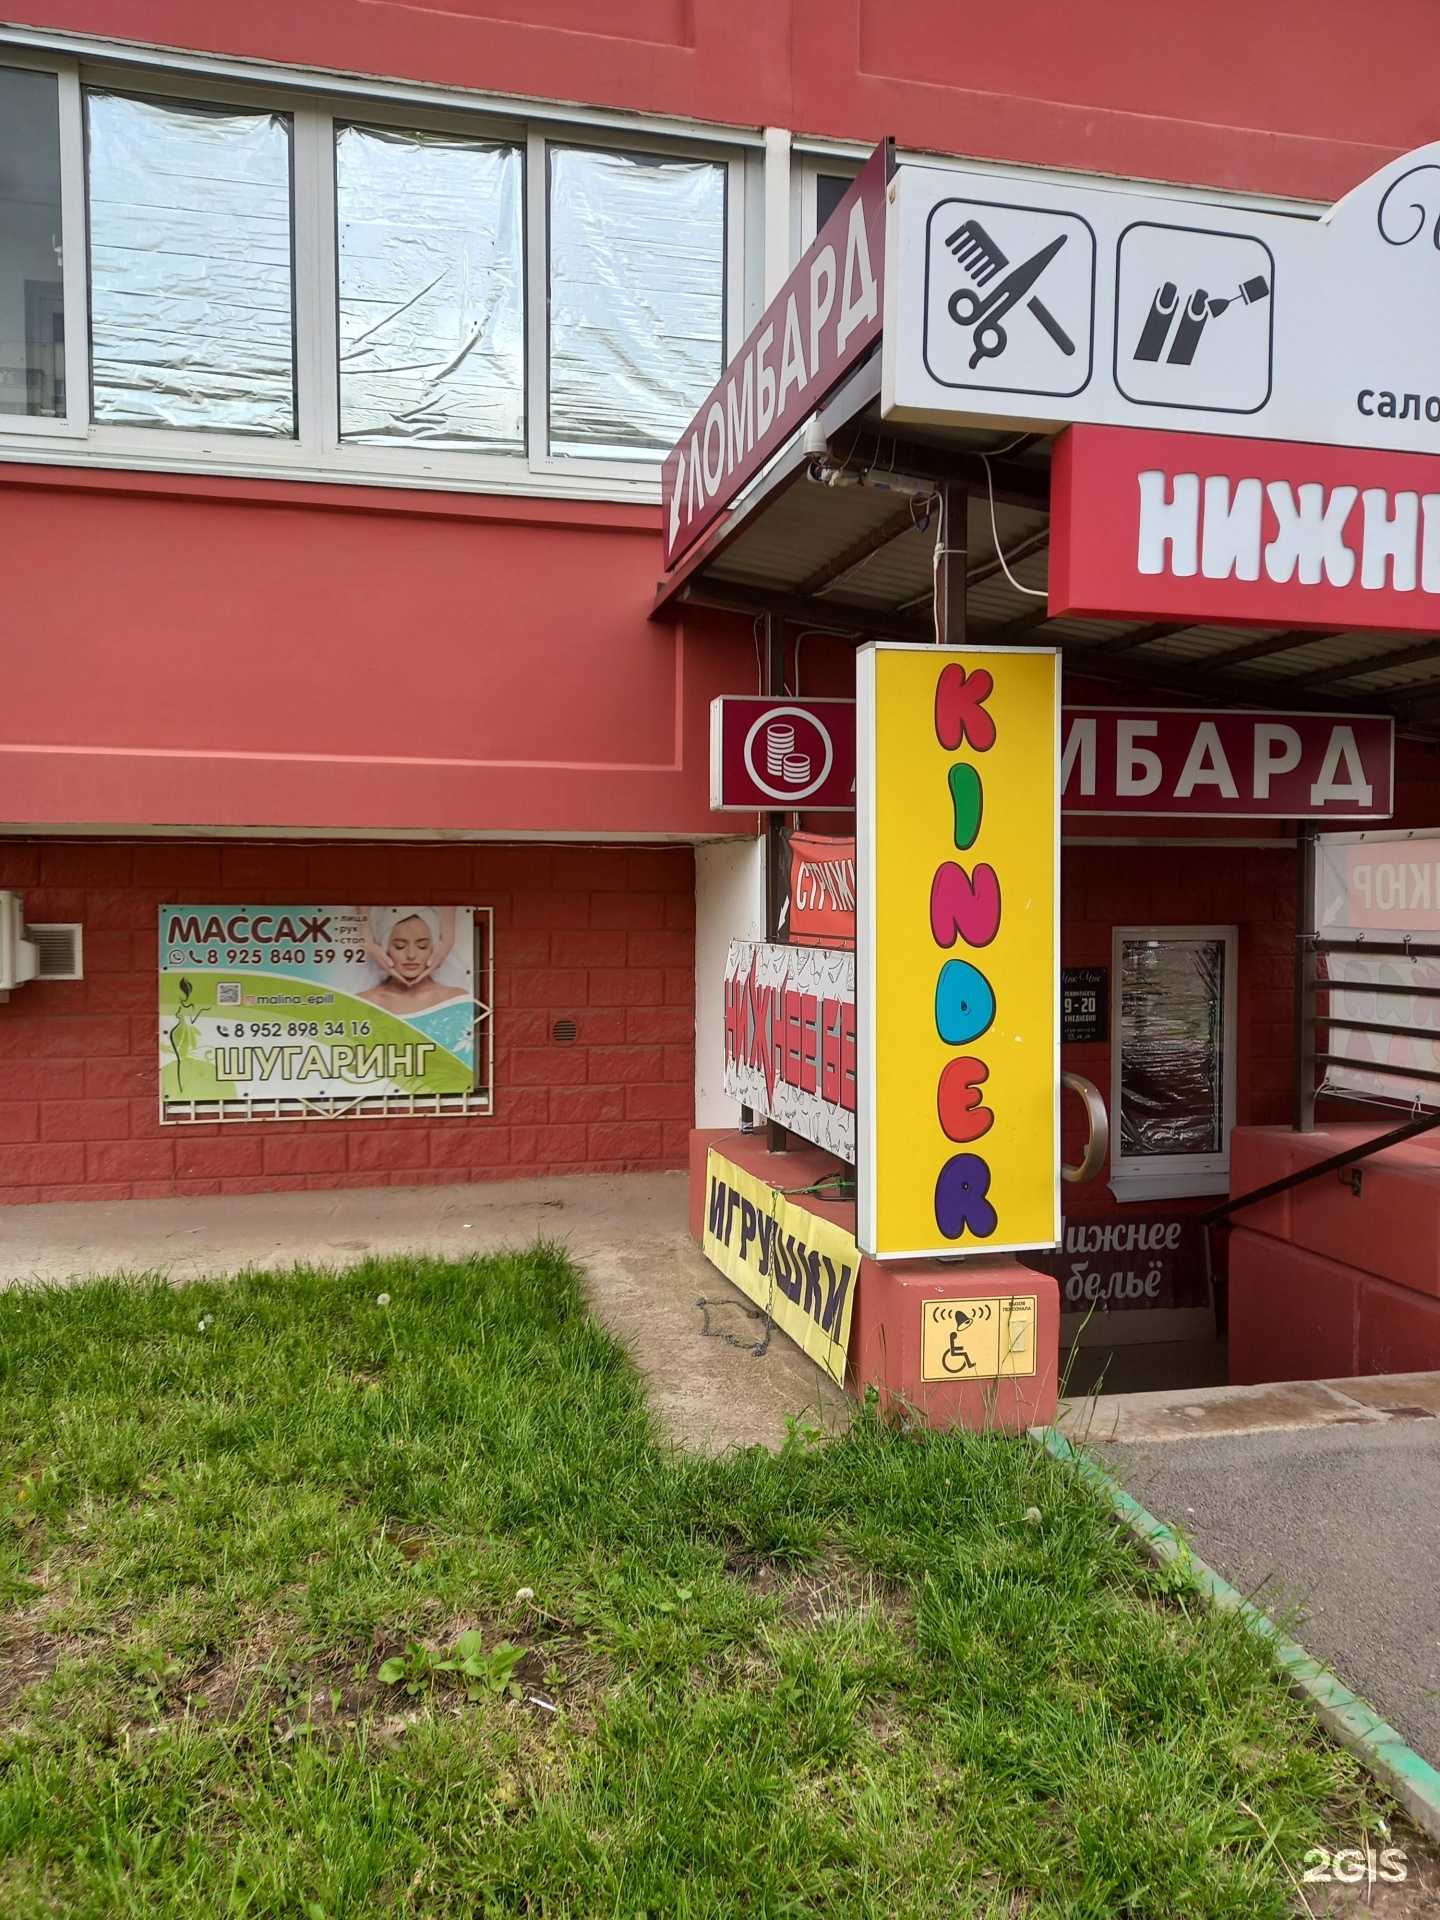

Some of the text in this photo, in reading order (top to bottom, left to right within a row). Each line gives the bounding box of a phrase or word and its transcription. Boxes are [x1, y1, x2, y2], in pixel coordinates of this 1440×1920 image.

[687, 197, 879, 525] ЛОМБАРД
[850, 718, 1373, 807] МБАРД
[796, 859, 855, 911] СТРИЖ
[168, 915, 333, 944] МАССАЖ
[930, 663, 1001, 1240] KINDER
[207, 949, 366, 964] 8 925 840 59 92
[234, 1021, 370, 1038] 8 952 898 34 16
[214, 1042, 437, 1082] ШУГАРИНГ
[709, 1176, 852, 1345] ИГРУШКИ
[1065, 1260, 1163, 1300] бельё
